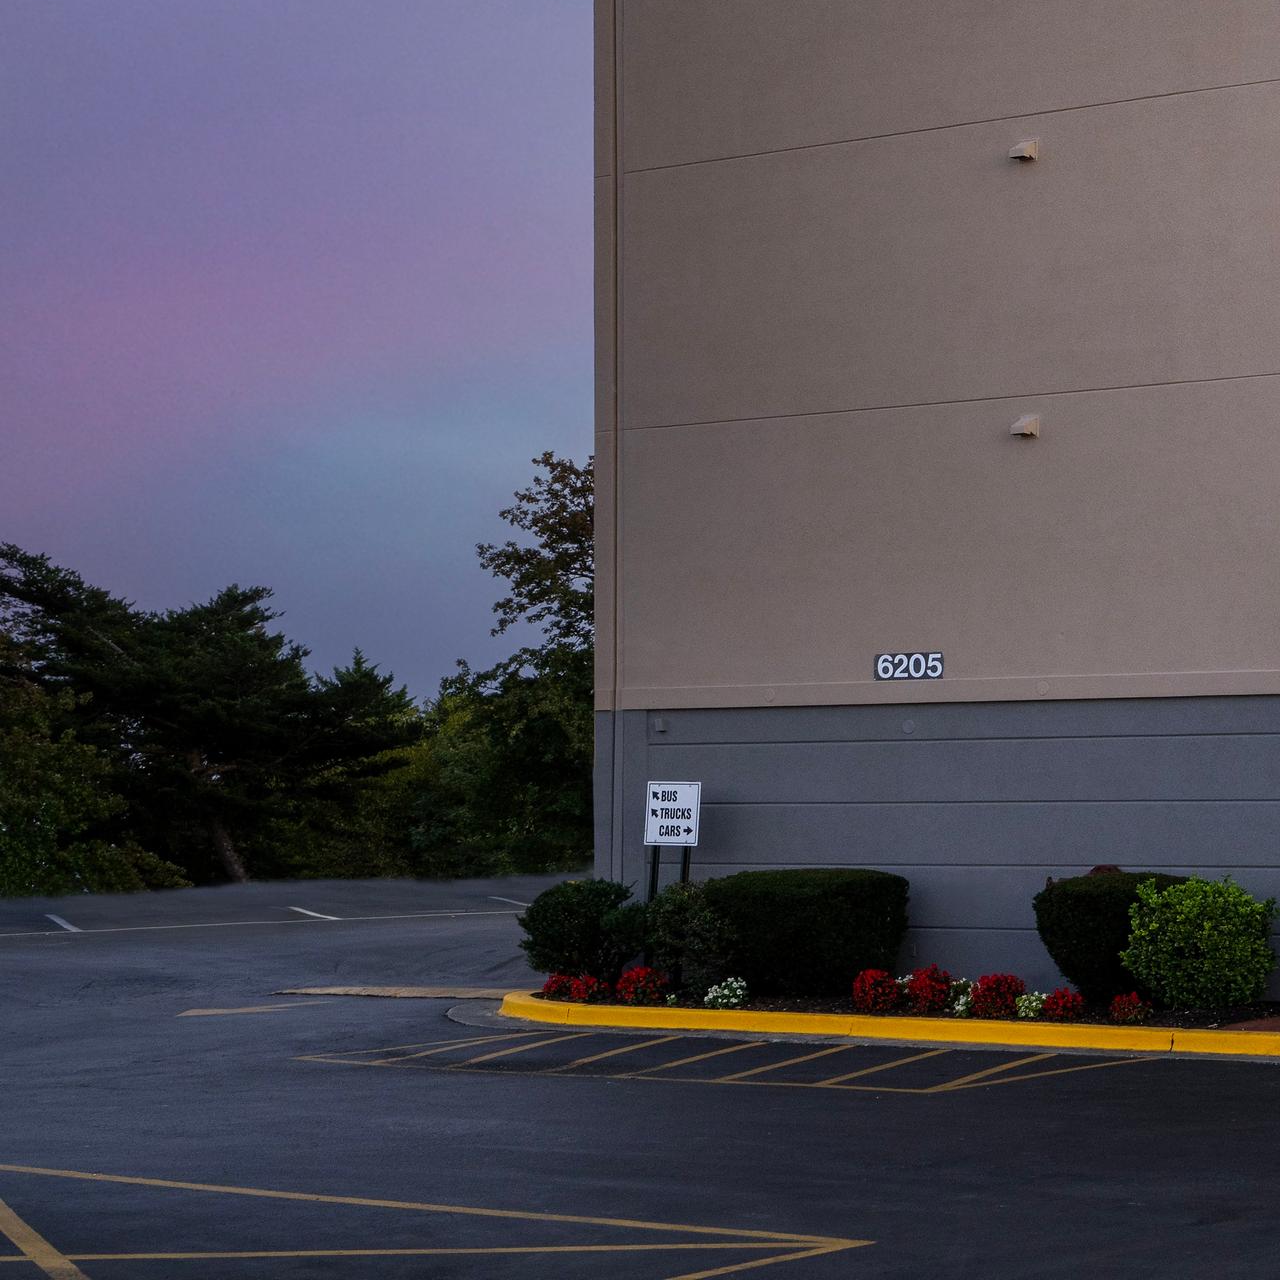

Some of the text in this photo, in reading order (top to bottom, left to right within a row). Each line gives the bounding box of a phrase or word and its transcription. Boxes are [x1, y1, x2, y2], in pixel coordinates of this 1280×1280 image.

[877, 653, 943, 679] 6205
[660, 790, 678, 802] BUS
[660, 808, 692, 820] TRUCKS
[658, 825, 681, 837] CARS
